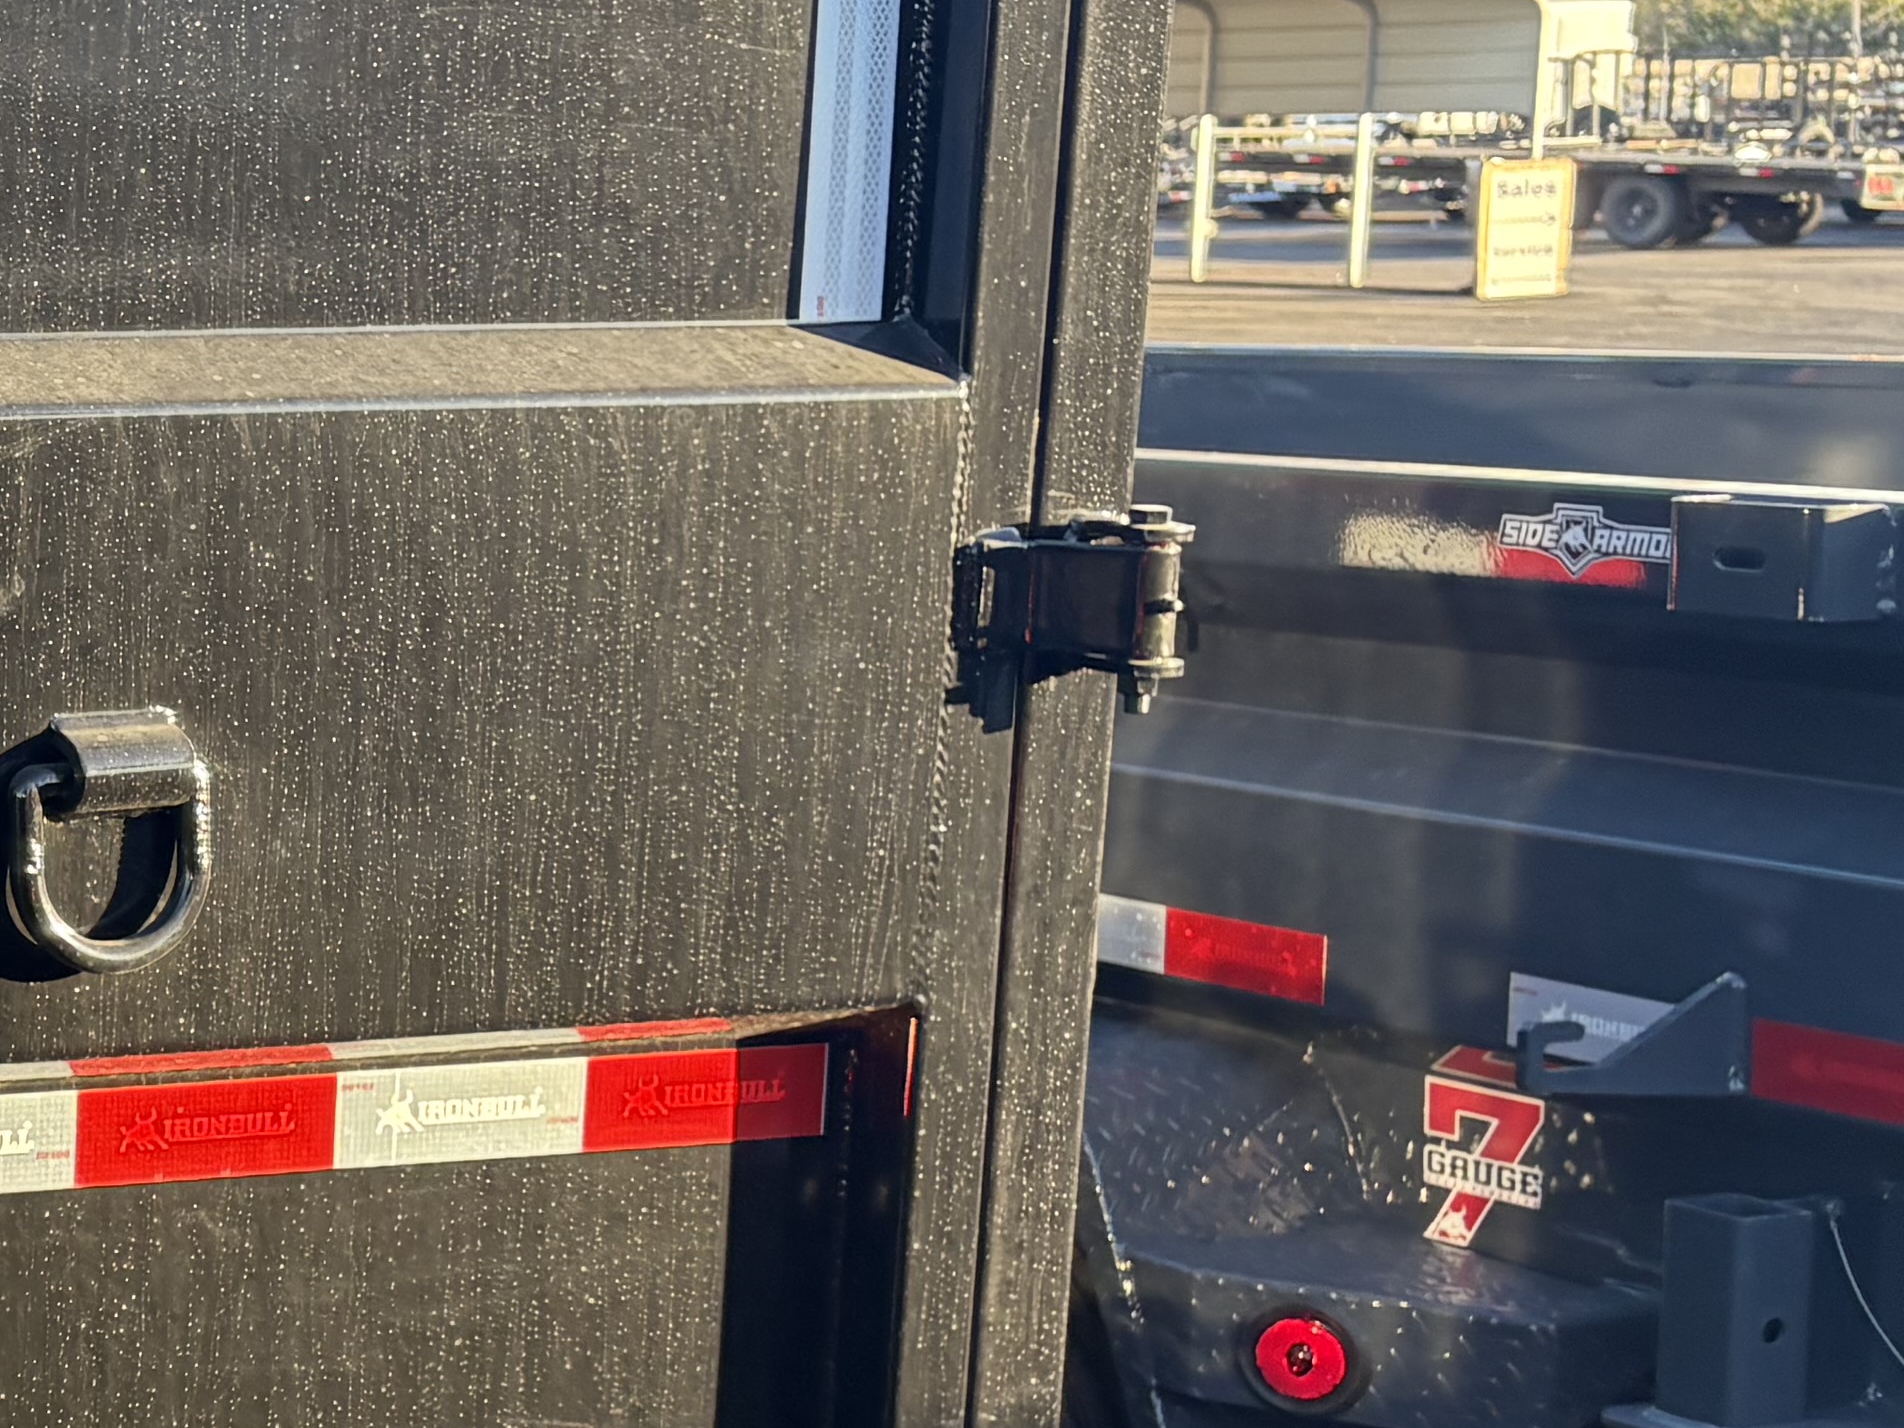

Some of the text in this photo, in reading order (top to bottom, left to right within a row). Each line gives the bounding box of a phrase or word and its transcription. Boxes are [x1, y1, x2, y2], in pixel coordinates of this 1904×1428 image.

[1502, 520, 1672, 558] SIDE ARMO
[163, 1103, 296, 1142] IRONBULL
[418, 1087, 546, 1125] IRONBULL
[1423, 1075, 1546, 1248] 7
[1426, 1149, 1541, 1199] GAUGE
